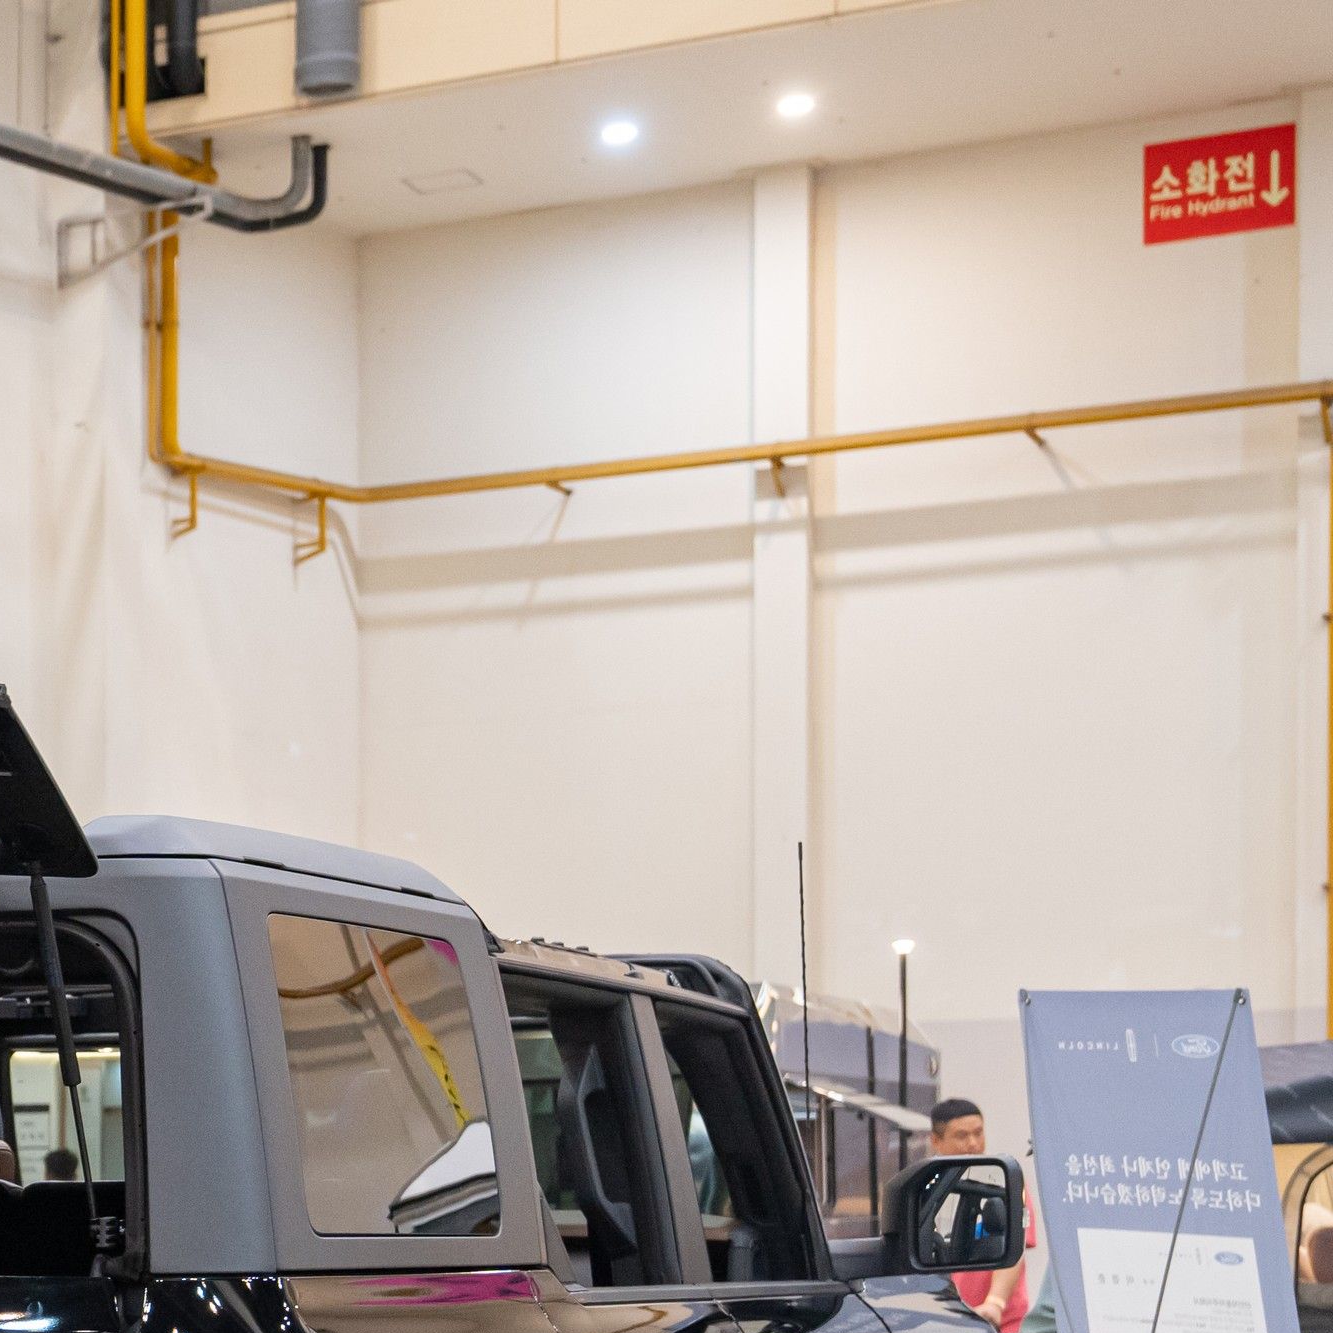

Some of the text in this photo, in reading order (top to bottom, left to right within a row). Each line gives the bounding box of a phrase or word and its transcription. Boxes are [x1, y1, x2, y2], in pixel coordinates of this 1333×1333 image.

[1149, 151, 1255, 202] 소화전
[1149, 192, 1255, 222] Fire Hydrant
